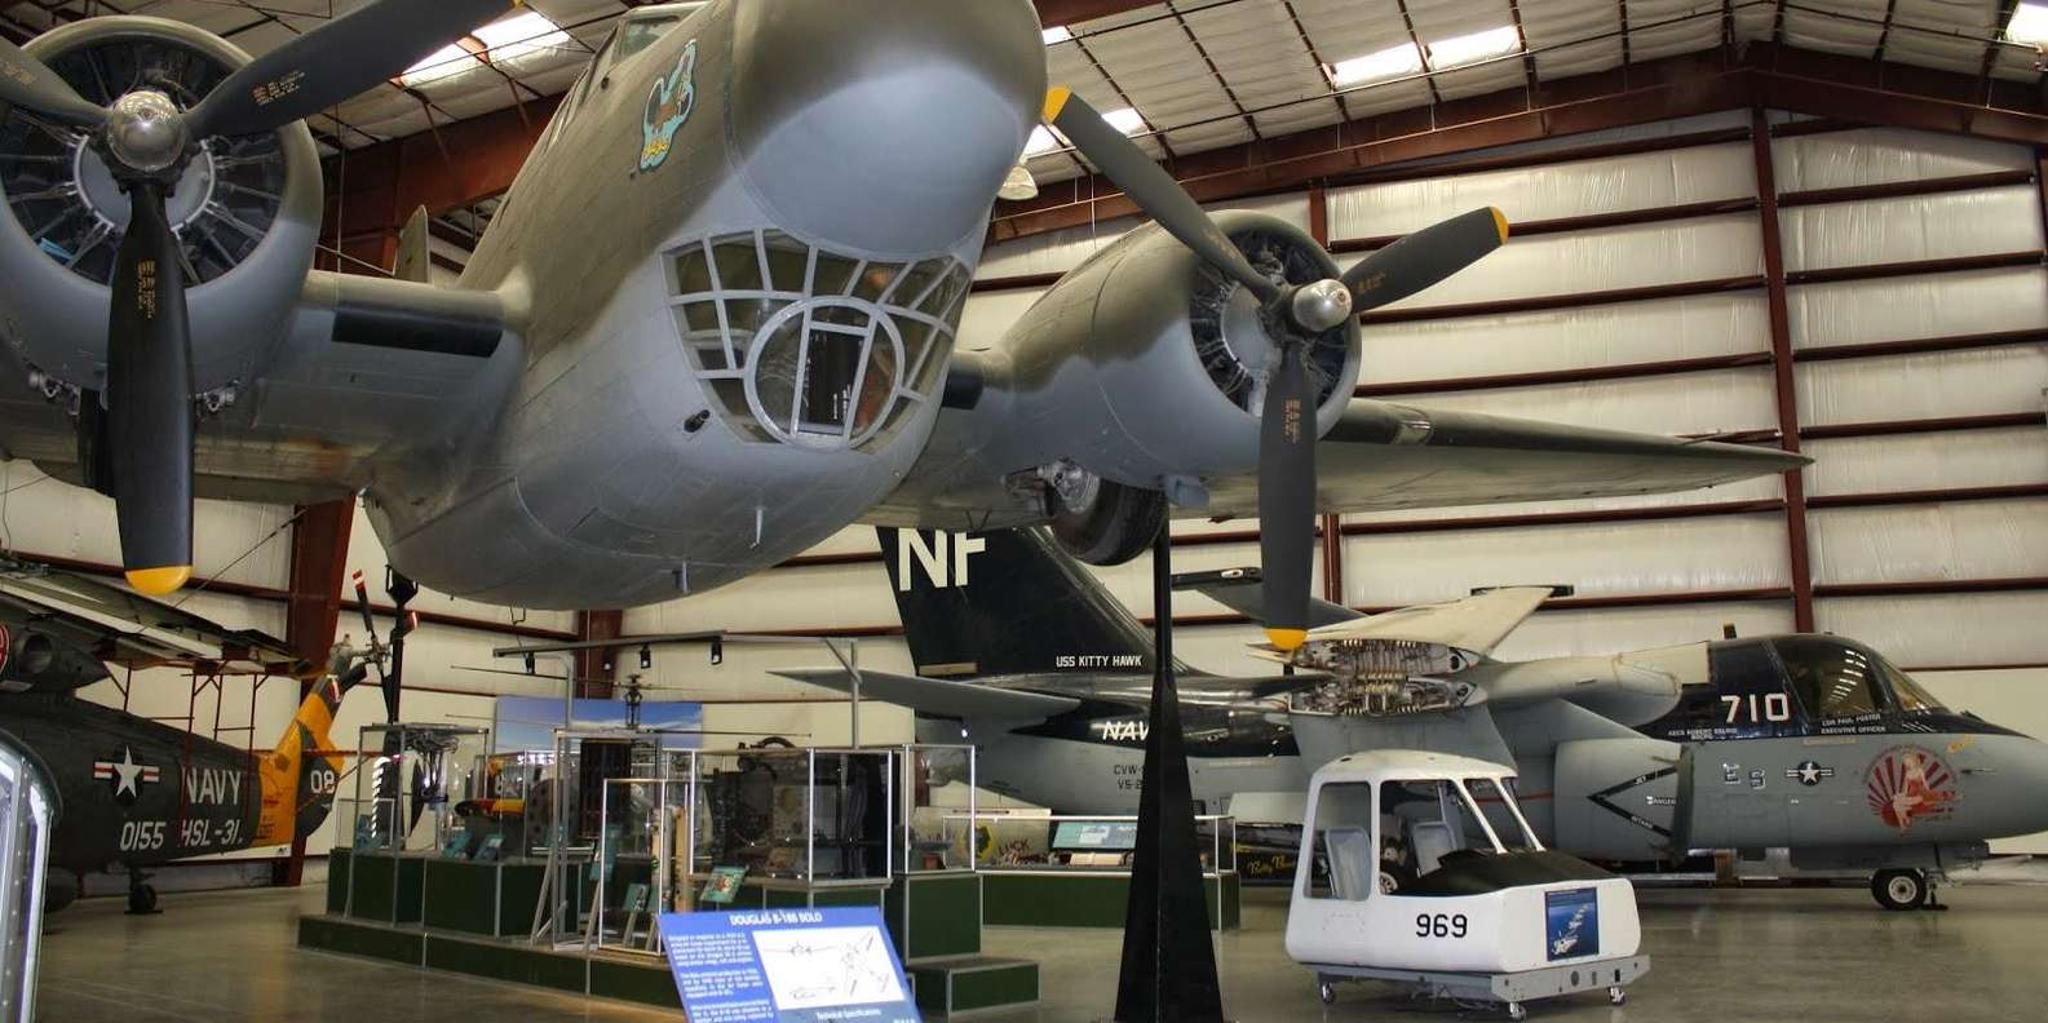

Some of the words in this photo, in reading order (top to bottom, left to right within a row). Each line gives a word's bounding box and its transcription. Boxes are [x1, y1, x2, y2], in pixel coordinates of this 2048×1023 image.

[898, 527, 986, 592] NF
[1056, 655, 1076, 668] USS
[1078, 655, 1109, 667] KITTY
[1112, 655, 1143, 667] HAWK
[1720, 692, 1789, 723] 710
[1102, 720, 1150, 741] NAV
[310, 770, 336, 794] 08
[1113, 765, 1145, 775] CVW-
[181, 767, 241, 805] NAVY
[120, 821, 167, 851] 0155
[730, 911, 772, 926] DOUGLAS
[799, 911, 823, 923] BOLO
[1416, 913, 1468, 938] 969
